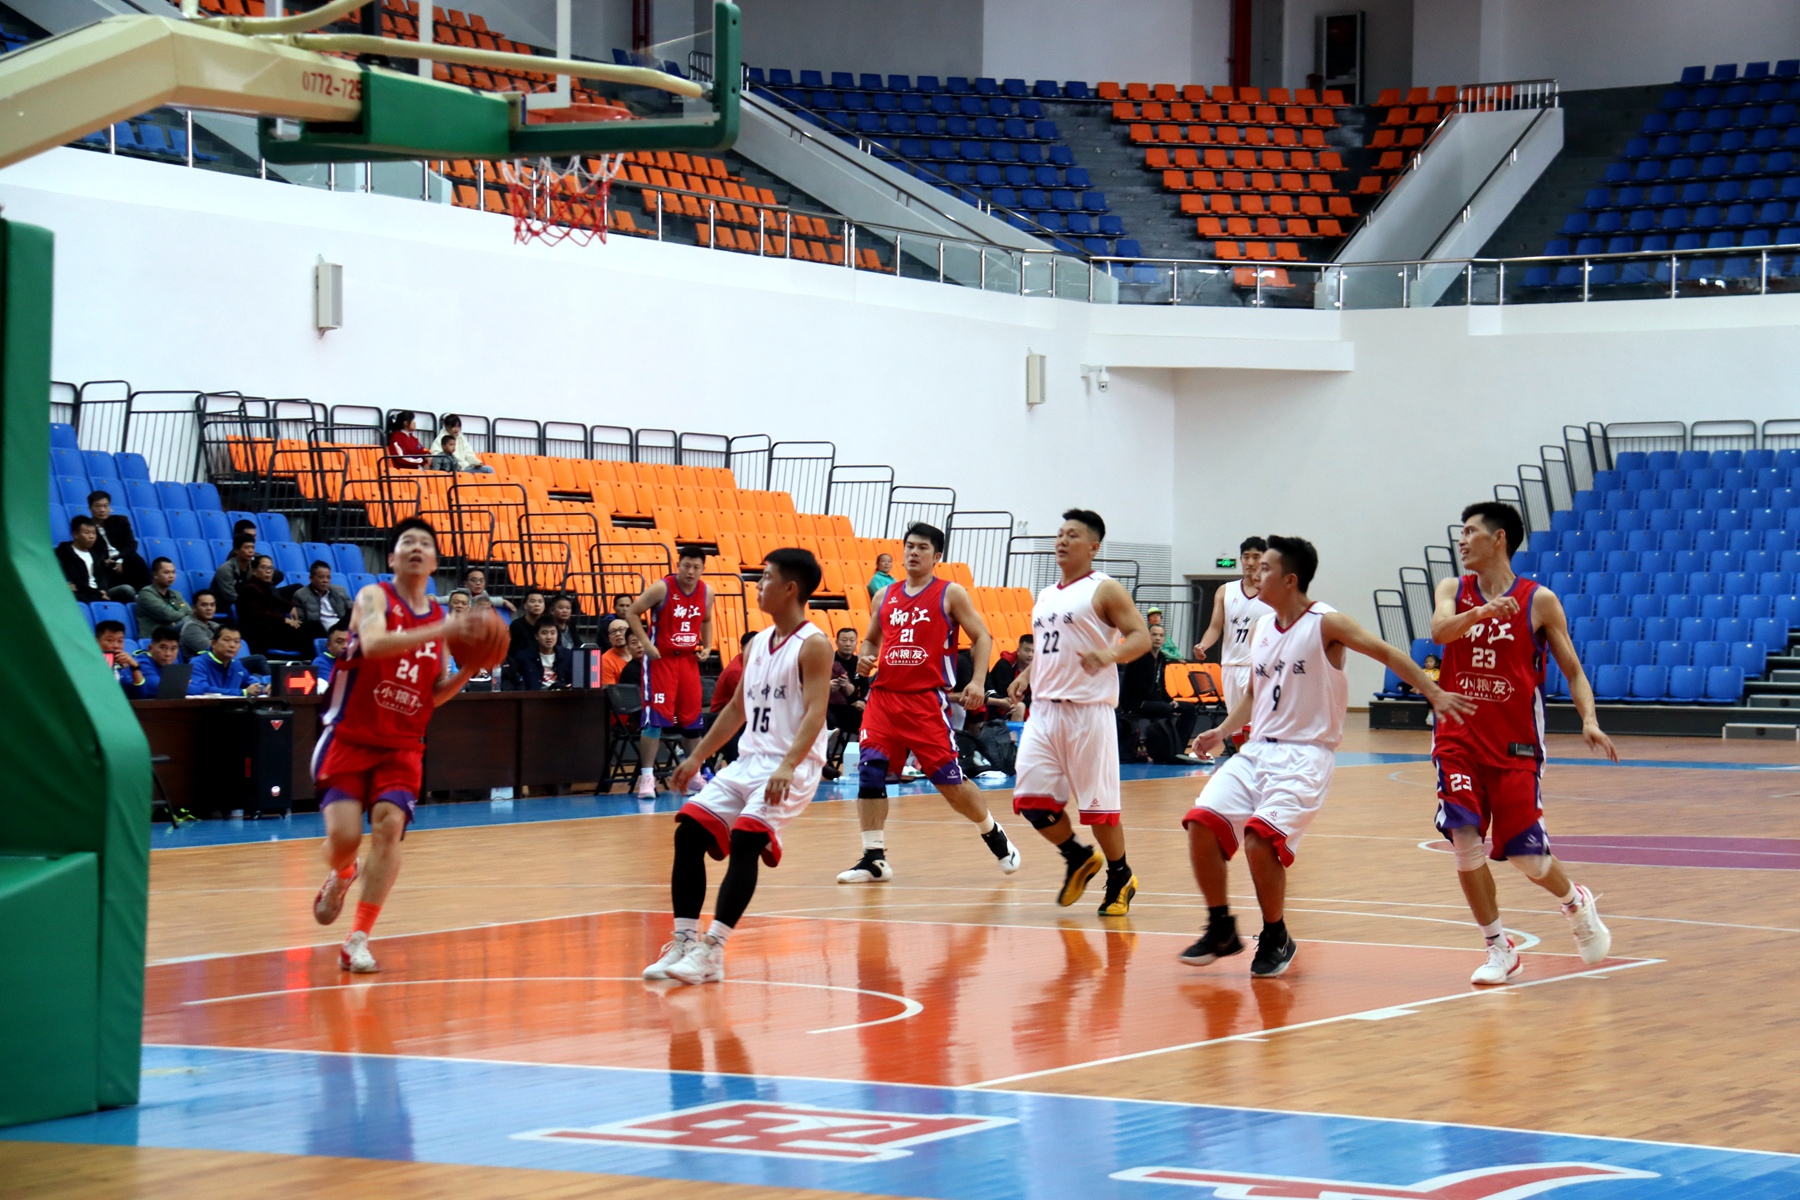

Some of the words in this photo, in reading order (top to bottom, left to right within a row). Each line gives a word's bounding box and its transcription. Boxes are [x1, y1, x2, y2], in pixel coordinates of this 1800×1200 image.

[673, 604, 701, 619] 柳江
[889, 607, 931, 627] 柳江
[680, 621, 691, 632] 15
[900, 628, 914, 643] 21
[1042, 630, 1060, 654] 22
[1235, 629, 1249, 644] 77
[889, 649, 923, 660] 小粮友
[1471, 647, 1497, 669] 23
[395, 658, 419, 684] 24
[1459, 676, 1507, 695] 小粮友
[653, 692, 665, 704] 15
[1272, 684, 1281, 711] 9
[752, 706, 771, 734] 15
[1449, 773, 1472, 792] 23
